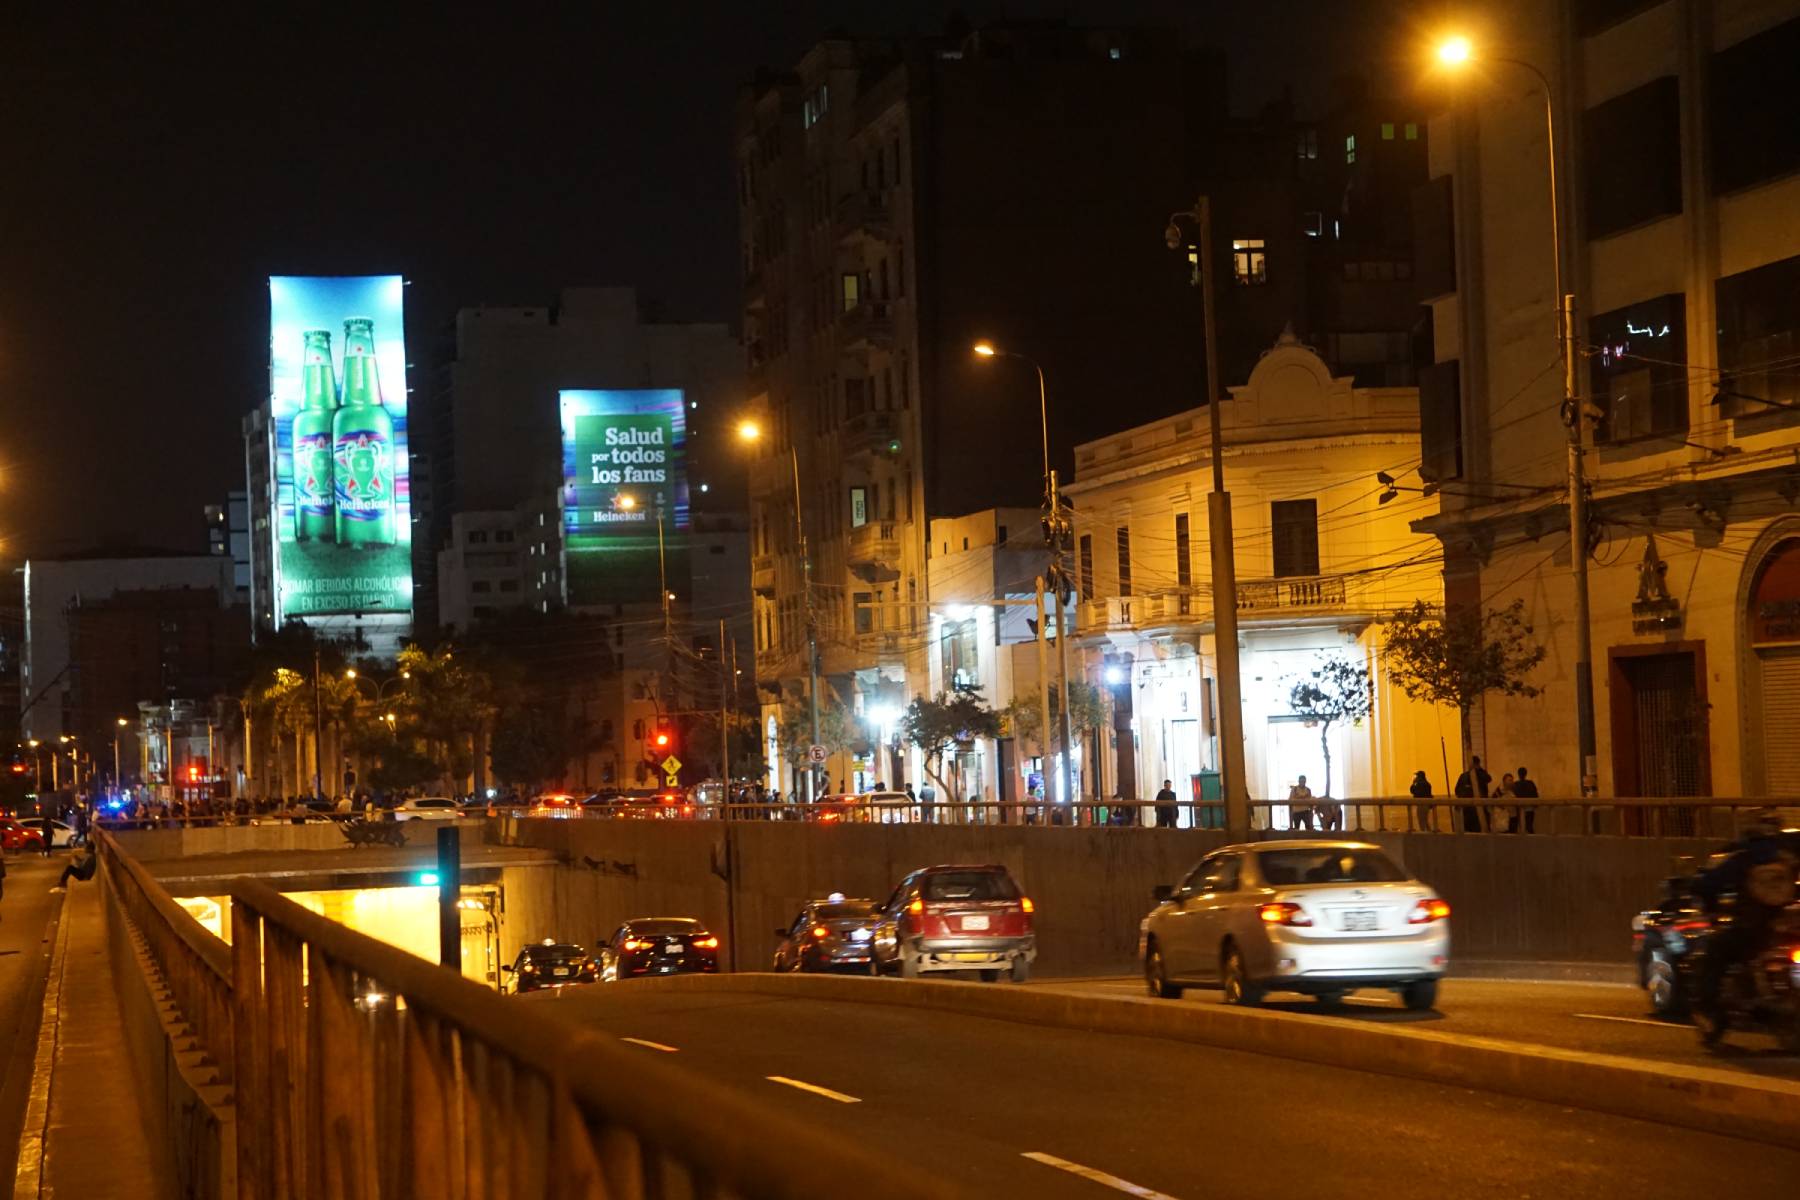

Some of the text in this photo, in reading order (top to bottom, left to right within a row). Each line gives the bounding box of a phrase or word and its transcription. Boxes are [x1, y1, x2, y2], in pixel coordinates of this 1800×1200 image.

[605, 427, 664, 446] Salud
[591, 447, 666, 464] por todos
[591, 466, 666, 484] los fans
[340, 498, 389, 510] Heineken
[593, 510, 646, 522] Heineken
[284, 574, 409, 593] OMAR BEBIDAS ALCOHÓLIC
[302, 597, 313, 610] EN
[315, 596, 348, 609] EXCESO
